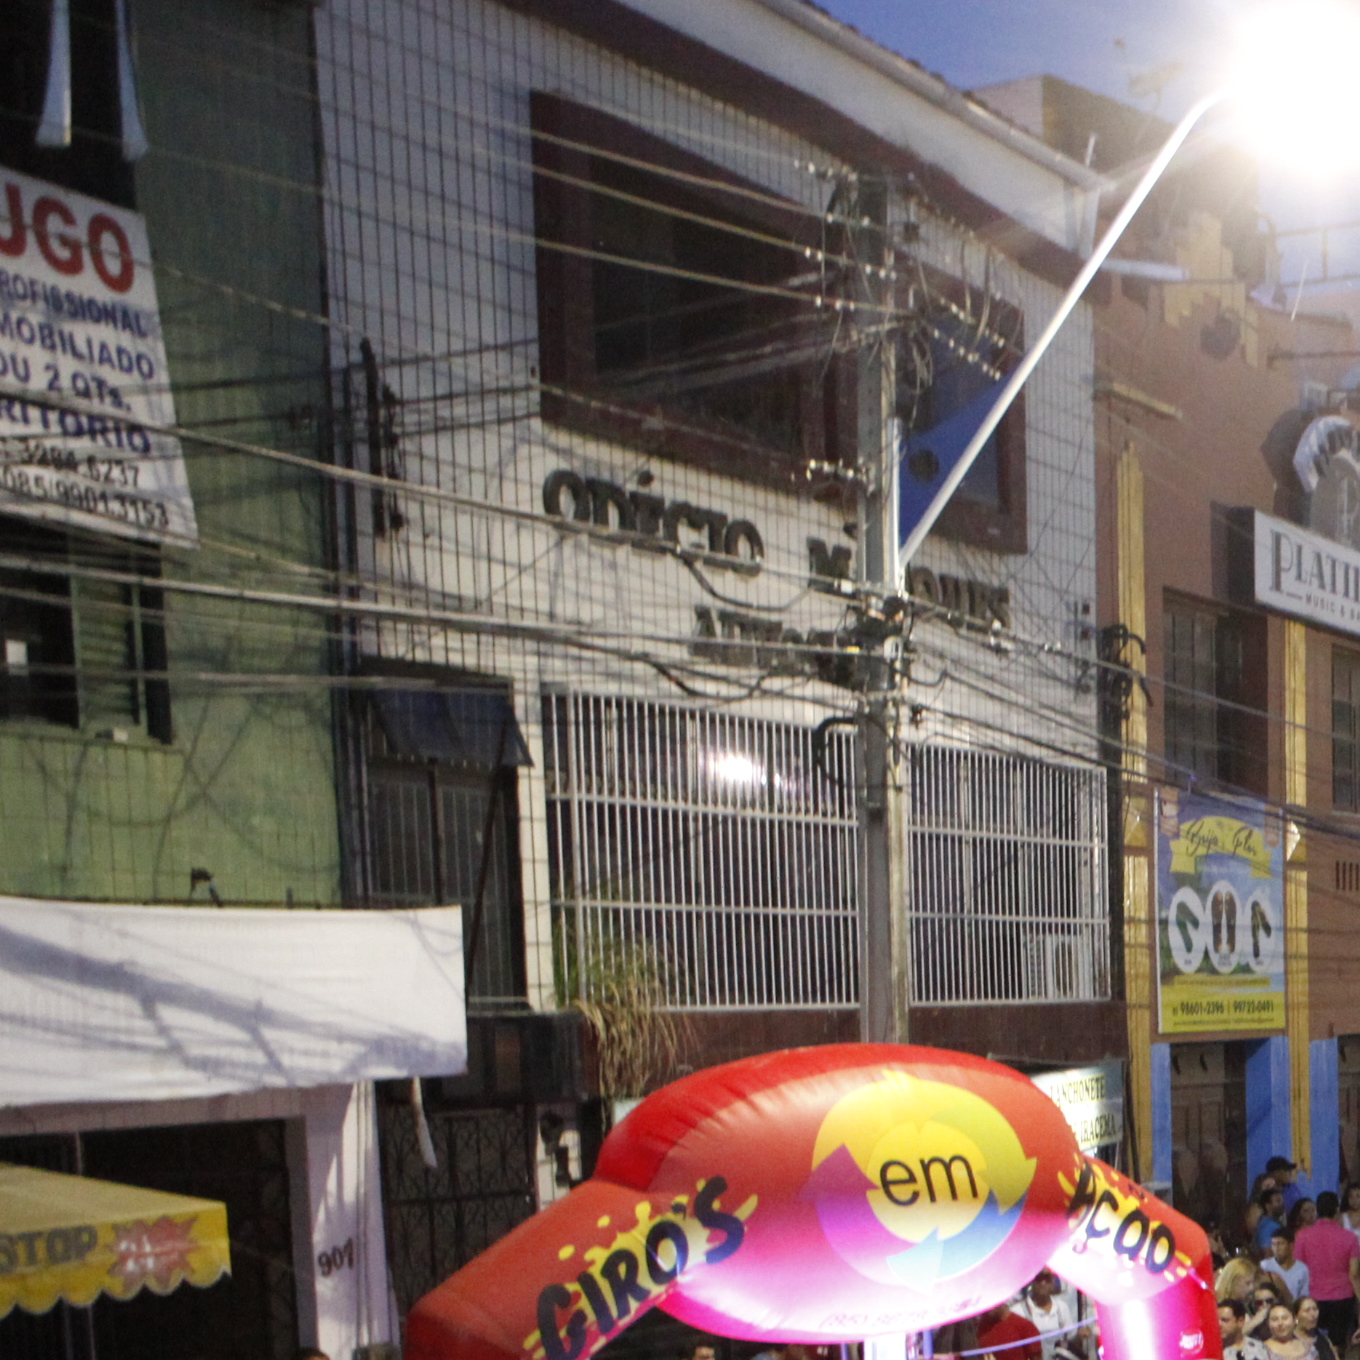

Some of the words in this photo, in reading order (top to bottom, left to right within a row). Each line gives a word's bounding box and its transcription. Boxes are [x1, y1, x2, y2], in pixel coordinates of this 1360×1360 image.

[44, 363, 60, 392] 2
[1305, 593, 1336, 614] MUSIC
[878, 1150, 979, 1208] em
